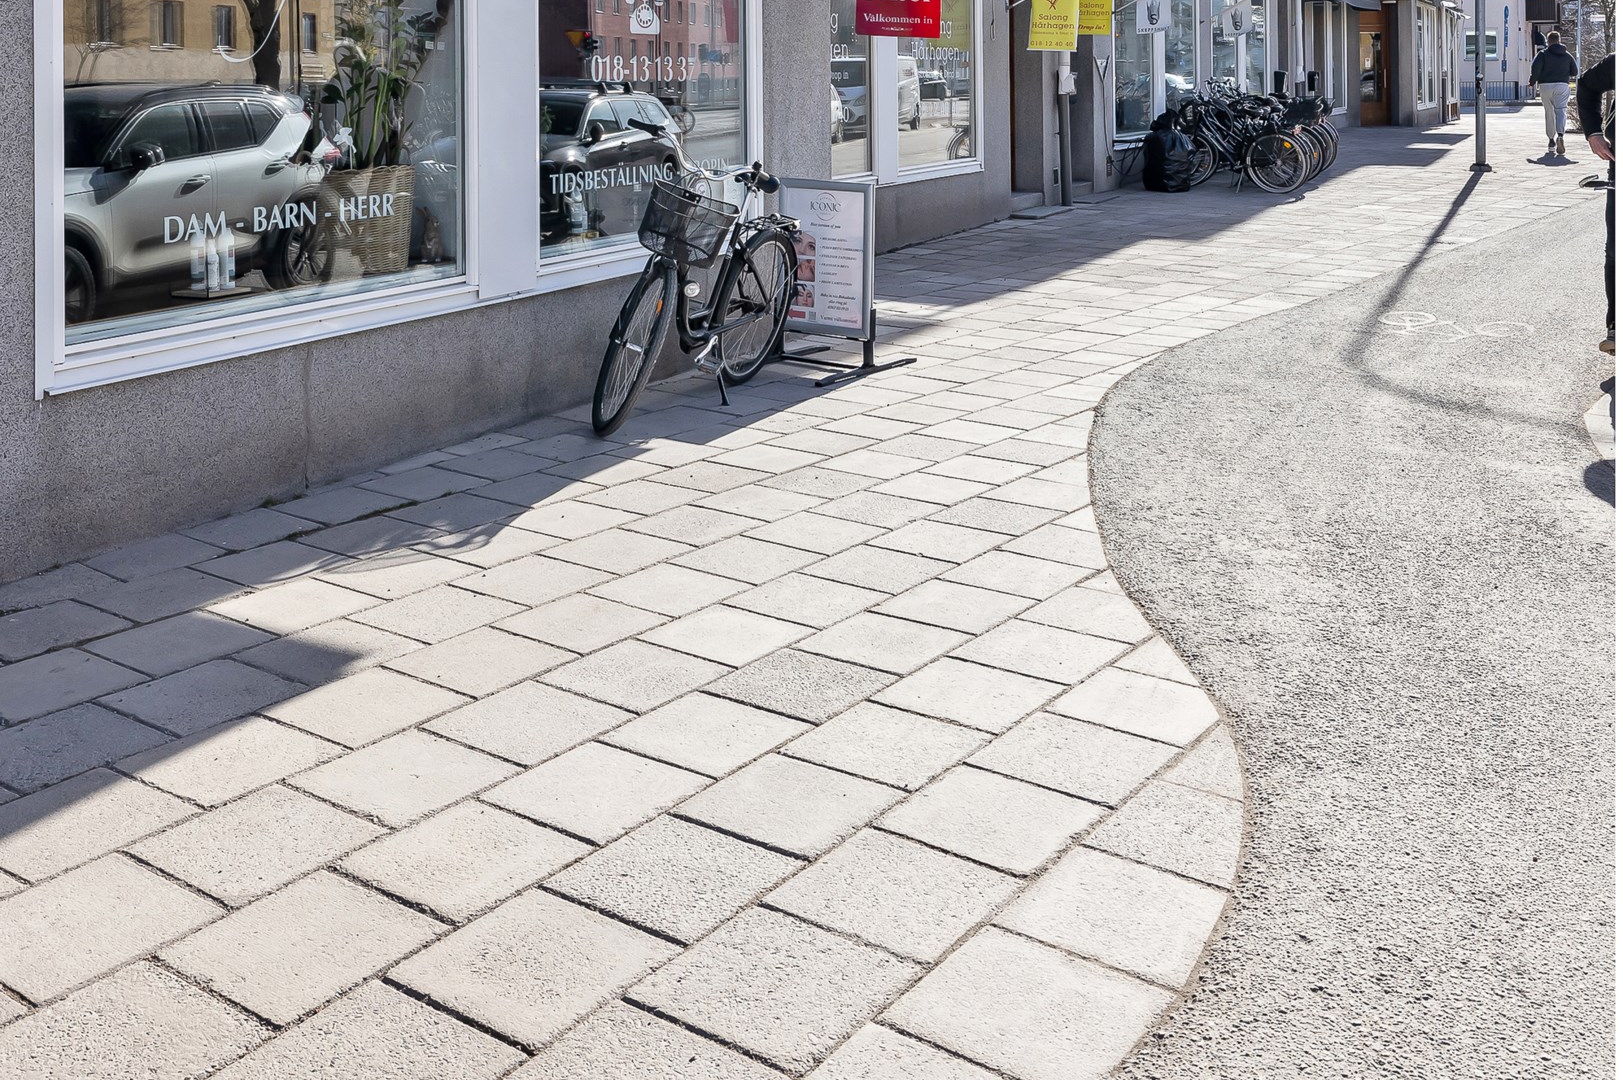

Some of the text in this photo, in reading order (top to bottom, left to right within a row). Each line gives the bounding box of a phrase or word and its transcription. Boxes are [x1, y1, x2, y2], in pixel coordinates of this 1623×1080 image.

[1080, 2, 1105, 10] Salong
[863, 12, 933, 25] Välkommen in
[1038, 13, 1069, 22] Salong
[1079, 9, 1110, 17] århagen
[1031, 21, 1075, 30] Hårhagen
[910, 40, 960, 65] Hårhagen
[591, 55, 697, 82] 018-13 13 37
[550, 162, 673, 194] TIDSBESTÄLLNING
[810, 200, 841, 213] ICONIC
[163, 210, 227, 244] DAM
[253, 200, 317, 233] BARN
[339, 193, 395, 222] HERR
